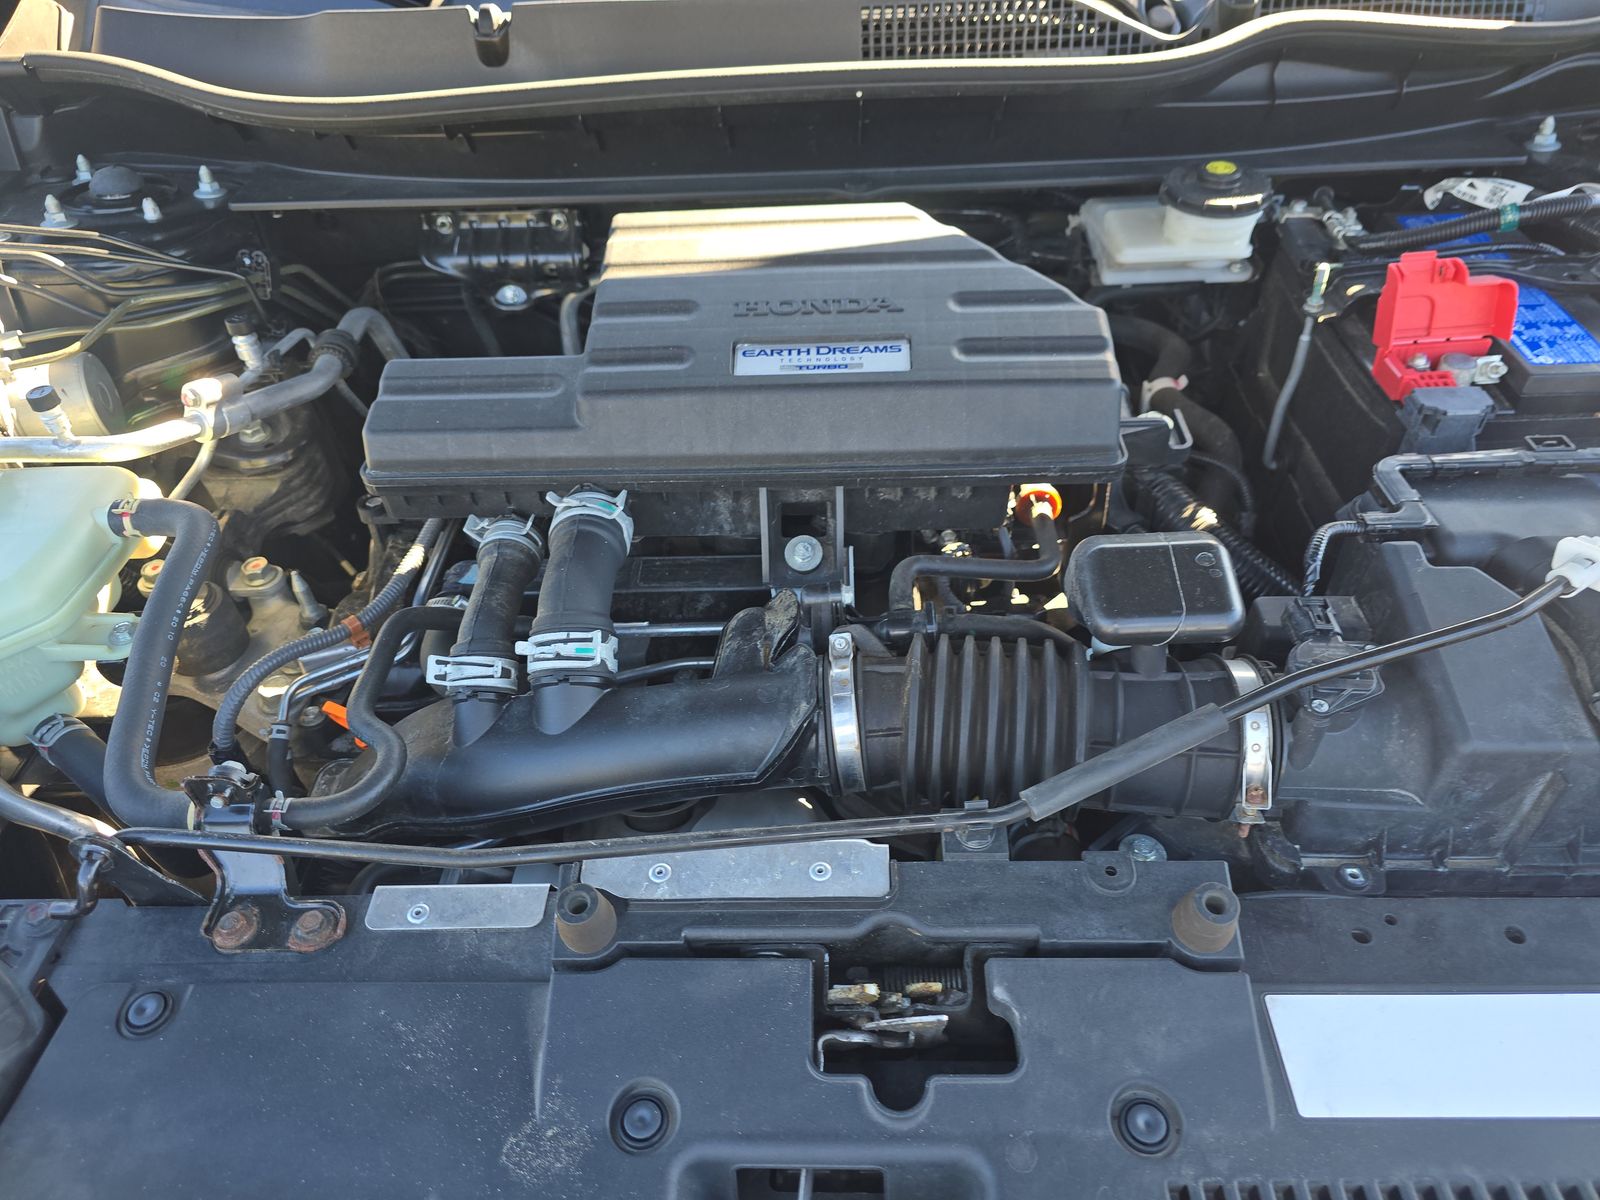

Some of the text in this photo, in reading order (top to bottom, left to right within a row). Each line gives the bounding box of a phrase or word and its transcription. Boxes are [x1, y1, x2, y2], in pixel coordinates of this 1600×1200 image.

[733, 298, 904, 317] HONDA
[742, 348, 811, 358] EARTH
[796, 363, 849, 371] TURBO
